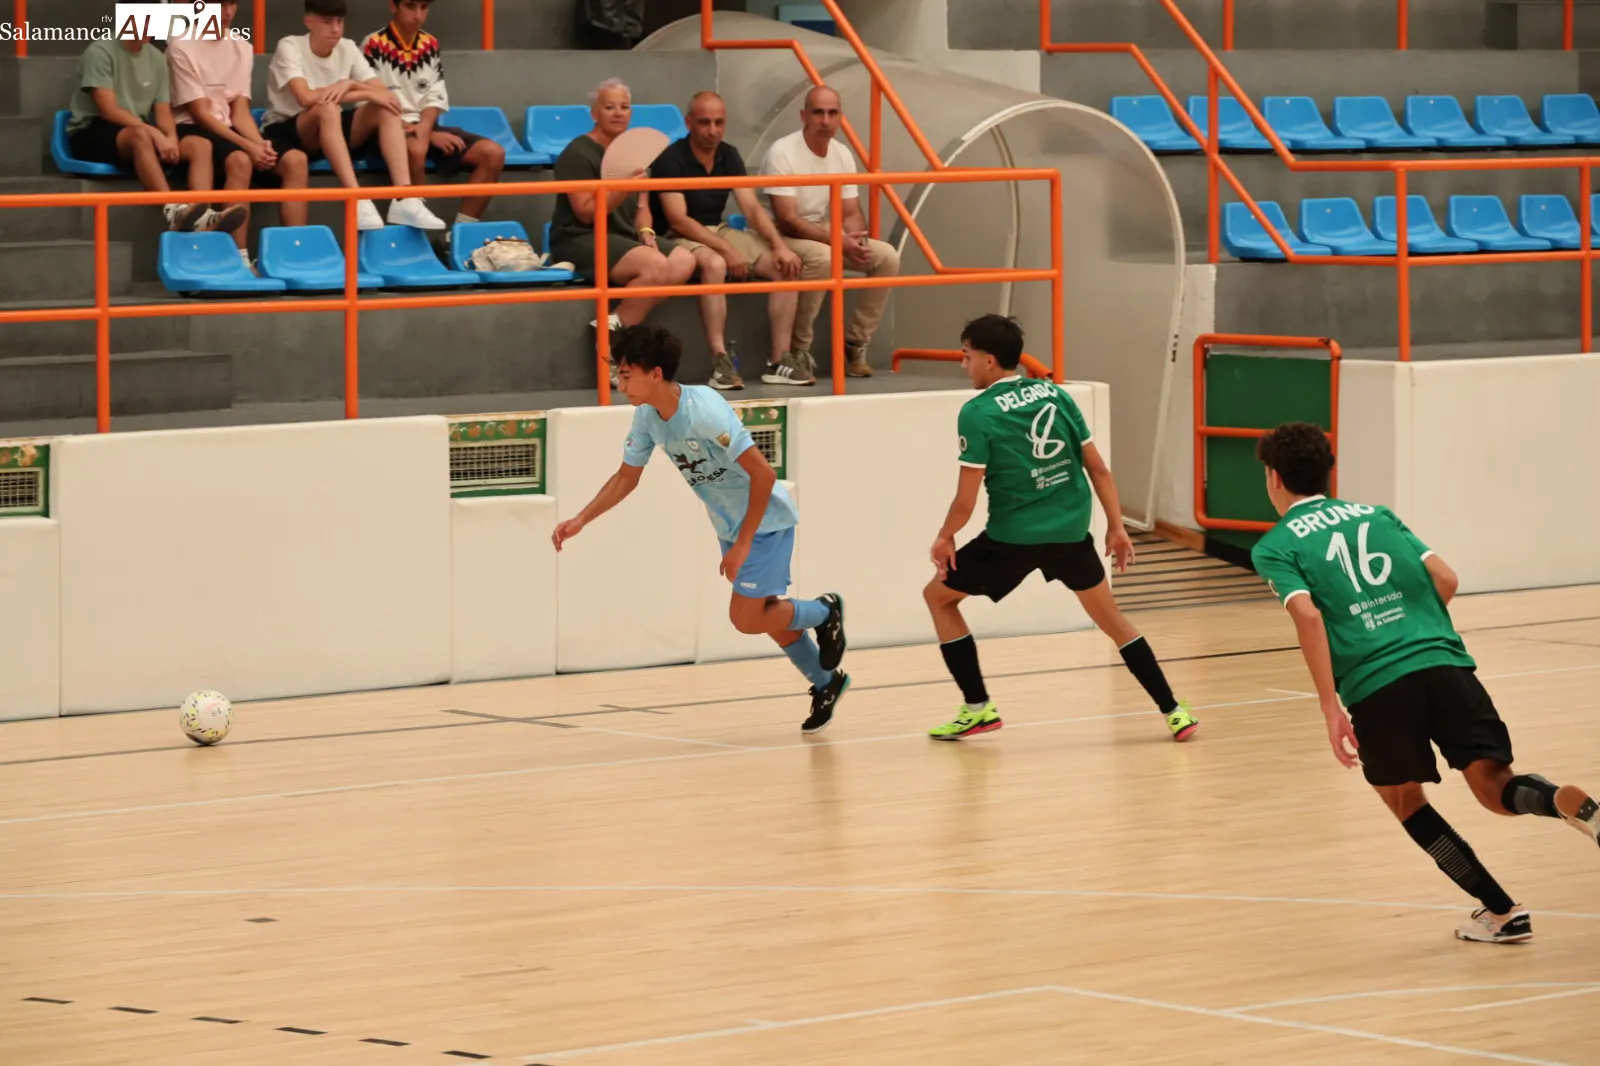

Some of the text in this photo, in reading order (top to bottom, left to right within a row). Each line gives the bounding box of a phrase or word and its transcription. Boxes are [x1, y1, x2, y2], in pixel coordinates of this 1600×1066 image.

[994, 382, 1058, 412] DELGADO
[1025, 402, 1066, 459] 8
[1286, 503, 1375, 538] BRUNO
[1325, 521, 1392, 593] 16
